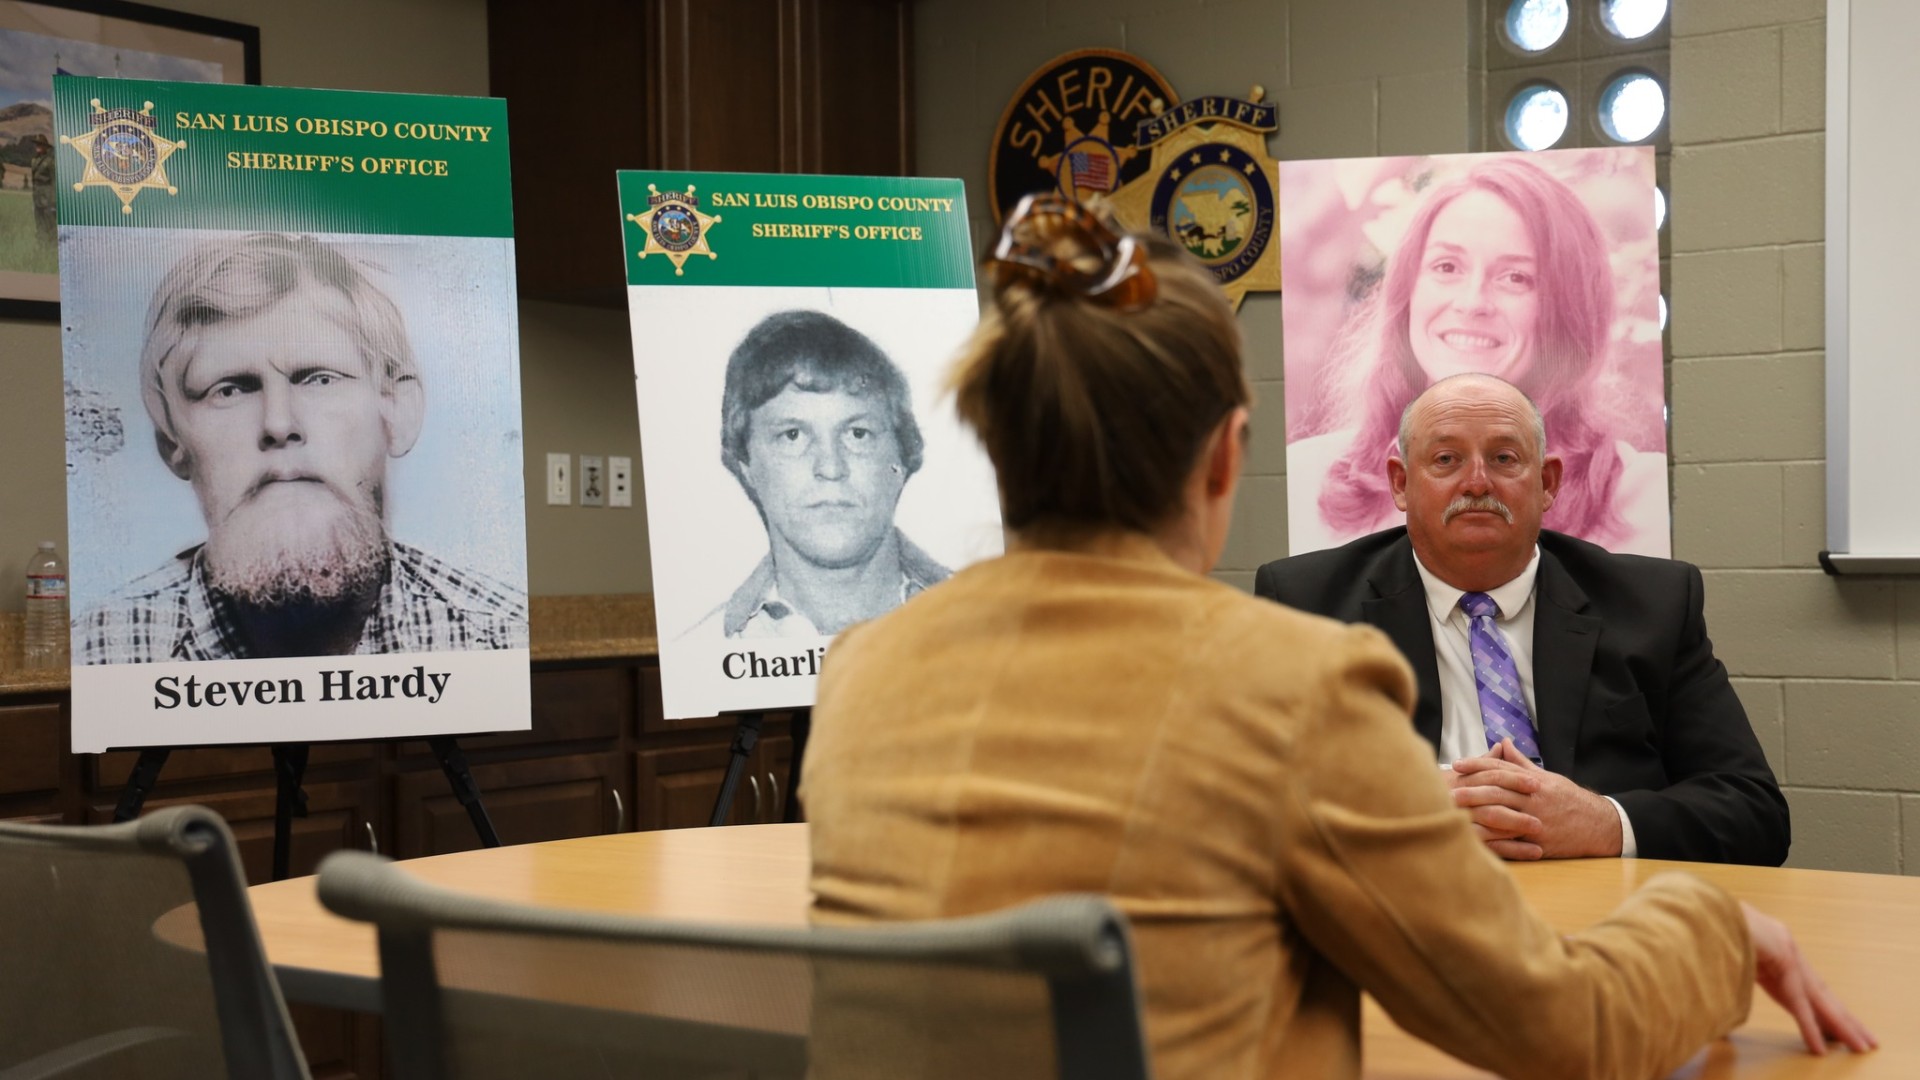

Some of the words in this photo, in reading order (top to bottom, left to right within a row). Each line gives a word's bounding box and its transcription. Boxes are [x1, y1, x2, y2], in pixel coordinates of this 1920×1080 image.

[94, 109, 153, 126] SHERIFF
[1010, 66, 1154, 157] SHERIF
[1148, 98, 1267, 140] SHERIFF
[176, 112, 225, 130] SAN
[233, 115, 289, 133] LUIS
[295, 118, 388, 138] OBISPO
[394, 122, 492, 142] COUNTY
[227, 152, 355, 173] SHERIFF'S
[361, 157, 449, 177] OFFICE
[712, 193, 750, 208] SAN
[755, 194, 798, 208] LUIS
[802, 195, 874, 210] OBISPO
[877, 198, 953, 212] COUNTY
[752, 223, 850, 239] SHERIFF'S
[854, 225, 923, 241] OFFICE
[1241, 206, 1273, 266] COUNTY
[153, 674, 306, 711] Steven
[318, 665, 452, 703] Hardy
